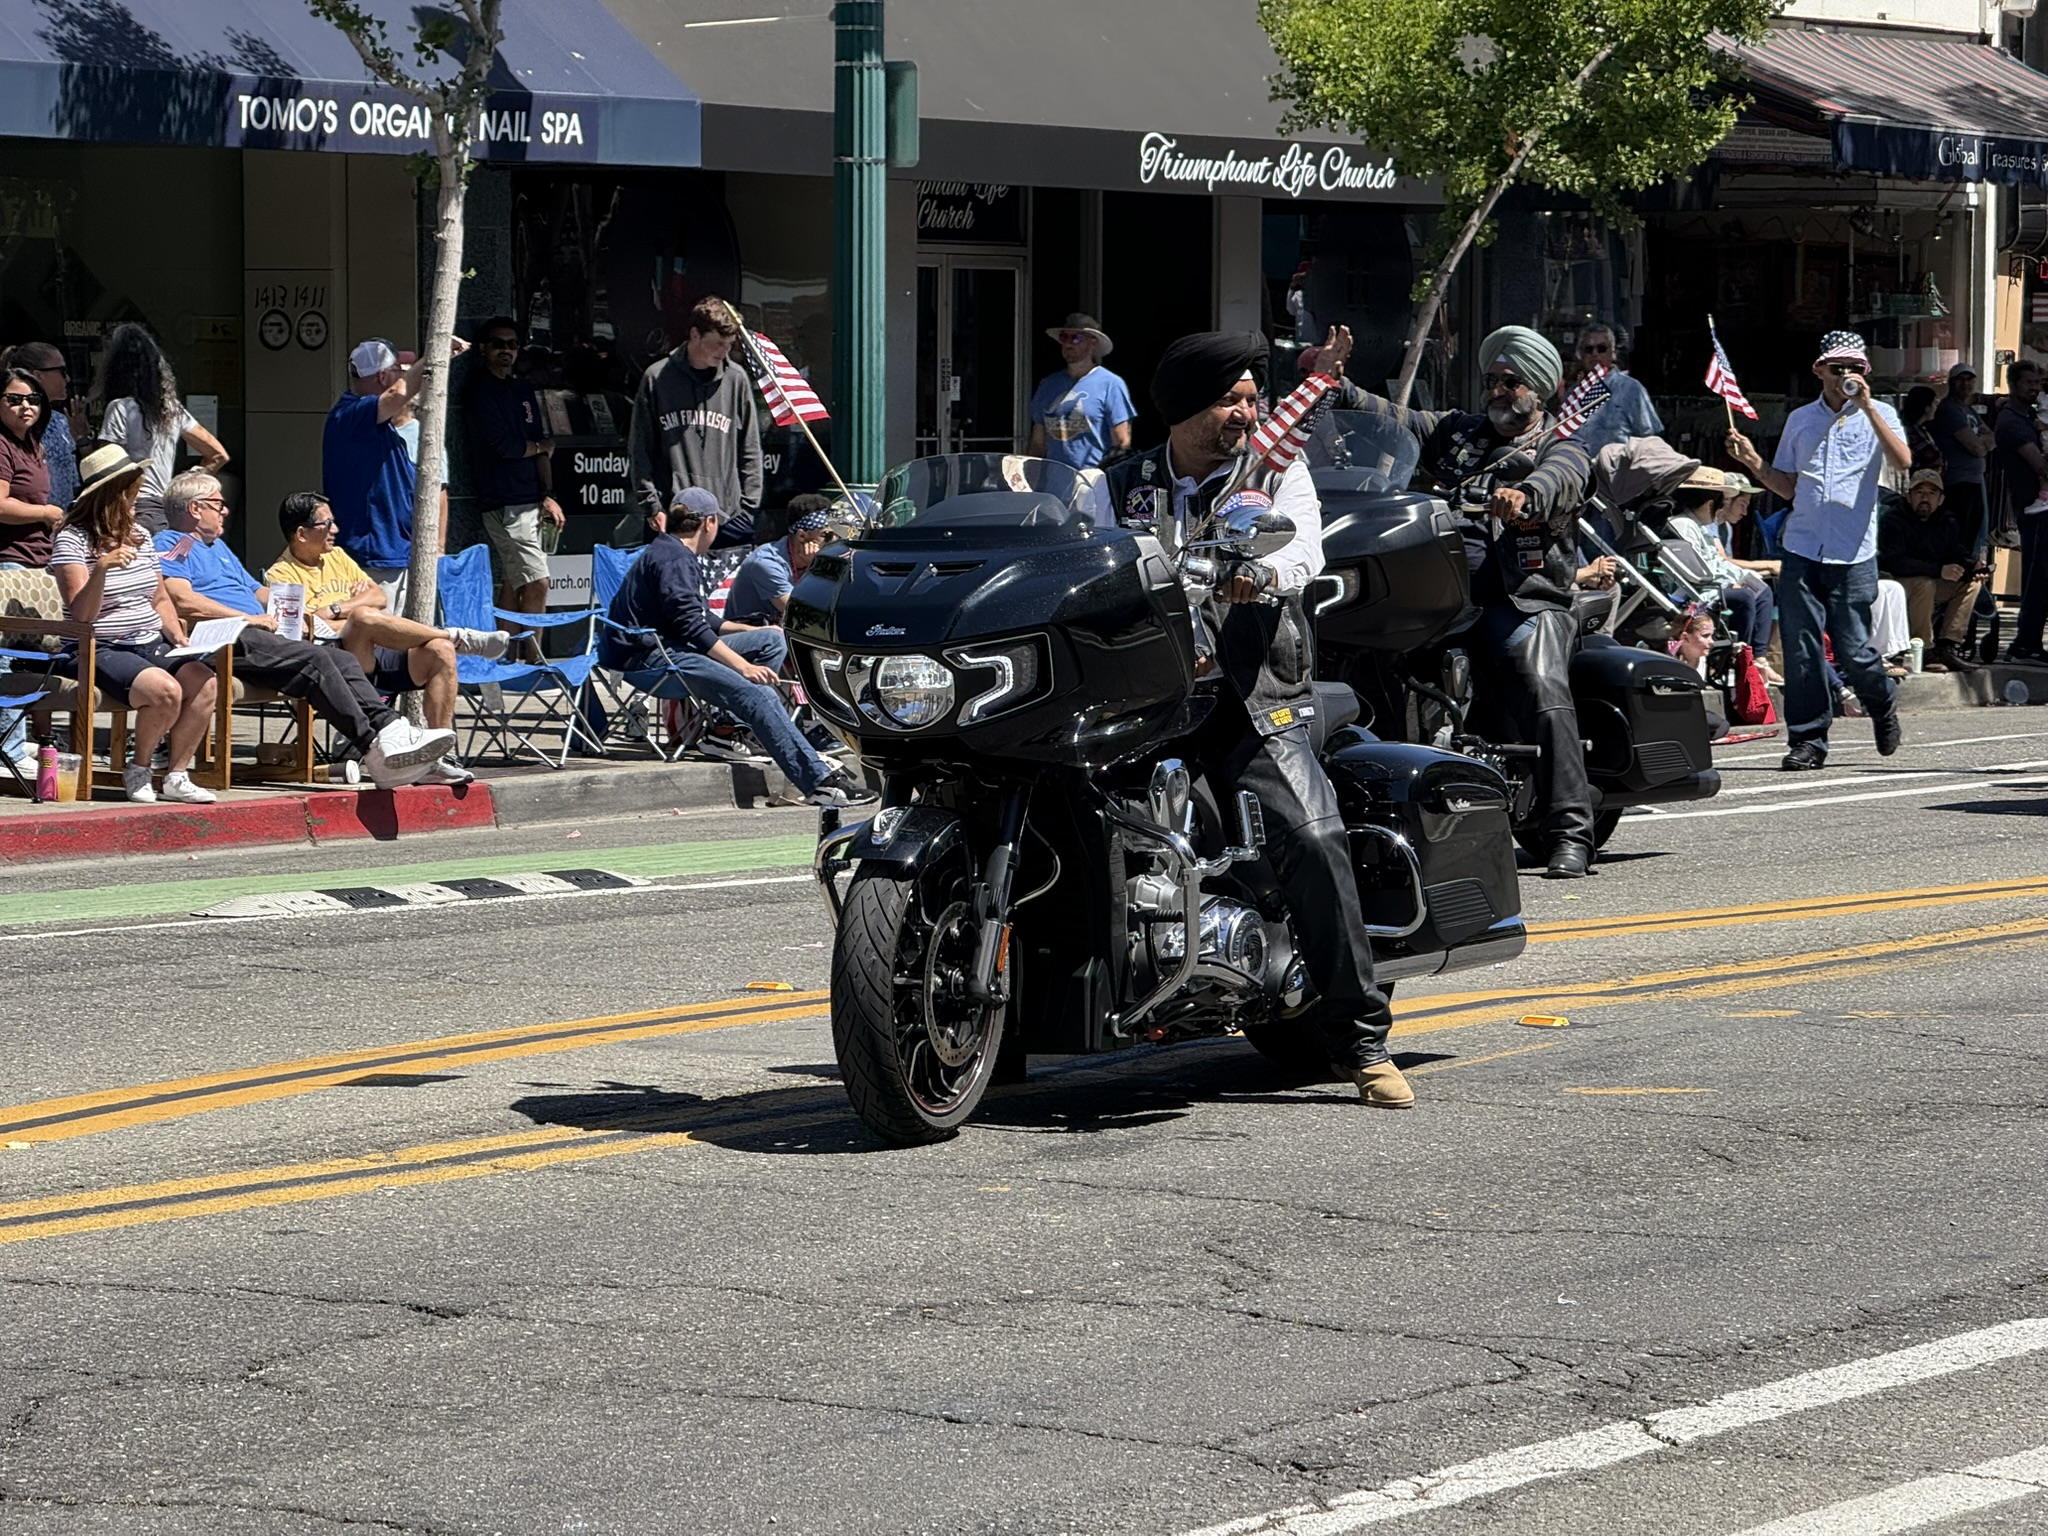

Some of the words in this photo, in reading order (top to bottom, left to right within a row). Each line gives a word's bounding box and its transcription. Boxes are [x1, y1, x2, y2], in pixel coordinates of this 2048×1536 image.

[238, 95, 338, 134] TOMO'S
[479, 110, 531, 143] NAIL
[541, 111, 583, 144] SPA
[1140, 132, 1274, 192] Triumphant
[1272, 143, 1317, 197] Life
[1320, 147, 1398, 191] Church
[1981, 141, 2037, 171] Treasures
[917, 198, 976, 230] Church
[254, 285, 288, 308] 1413
[294, 286, 325, 308] 1411
[659, 411, 680, 431] SAN
[573, 451, 630, 478] Sunday
[579, 483, 599, 505] 10
[601, 487, 625, 505] am
